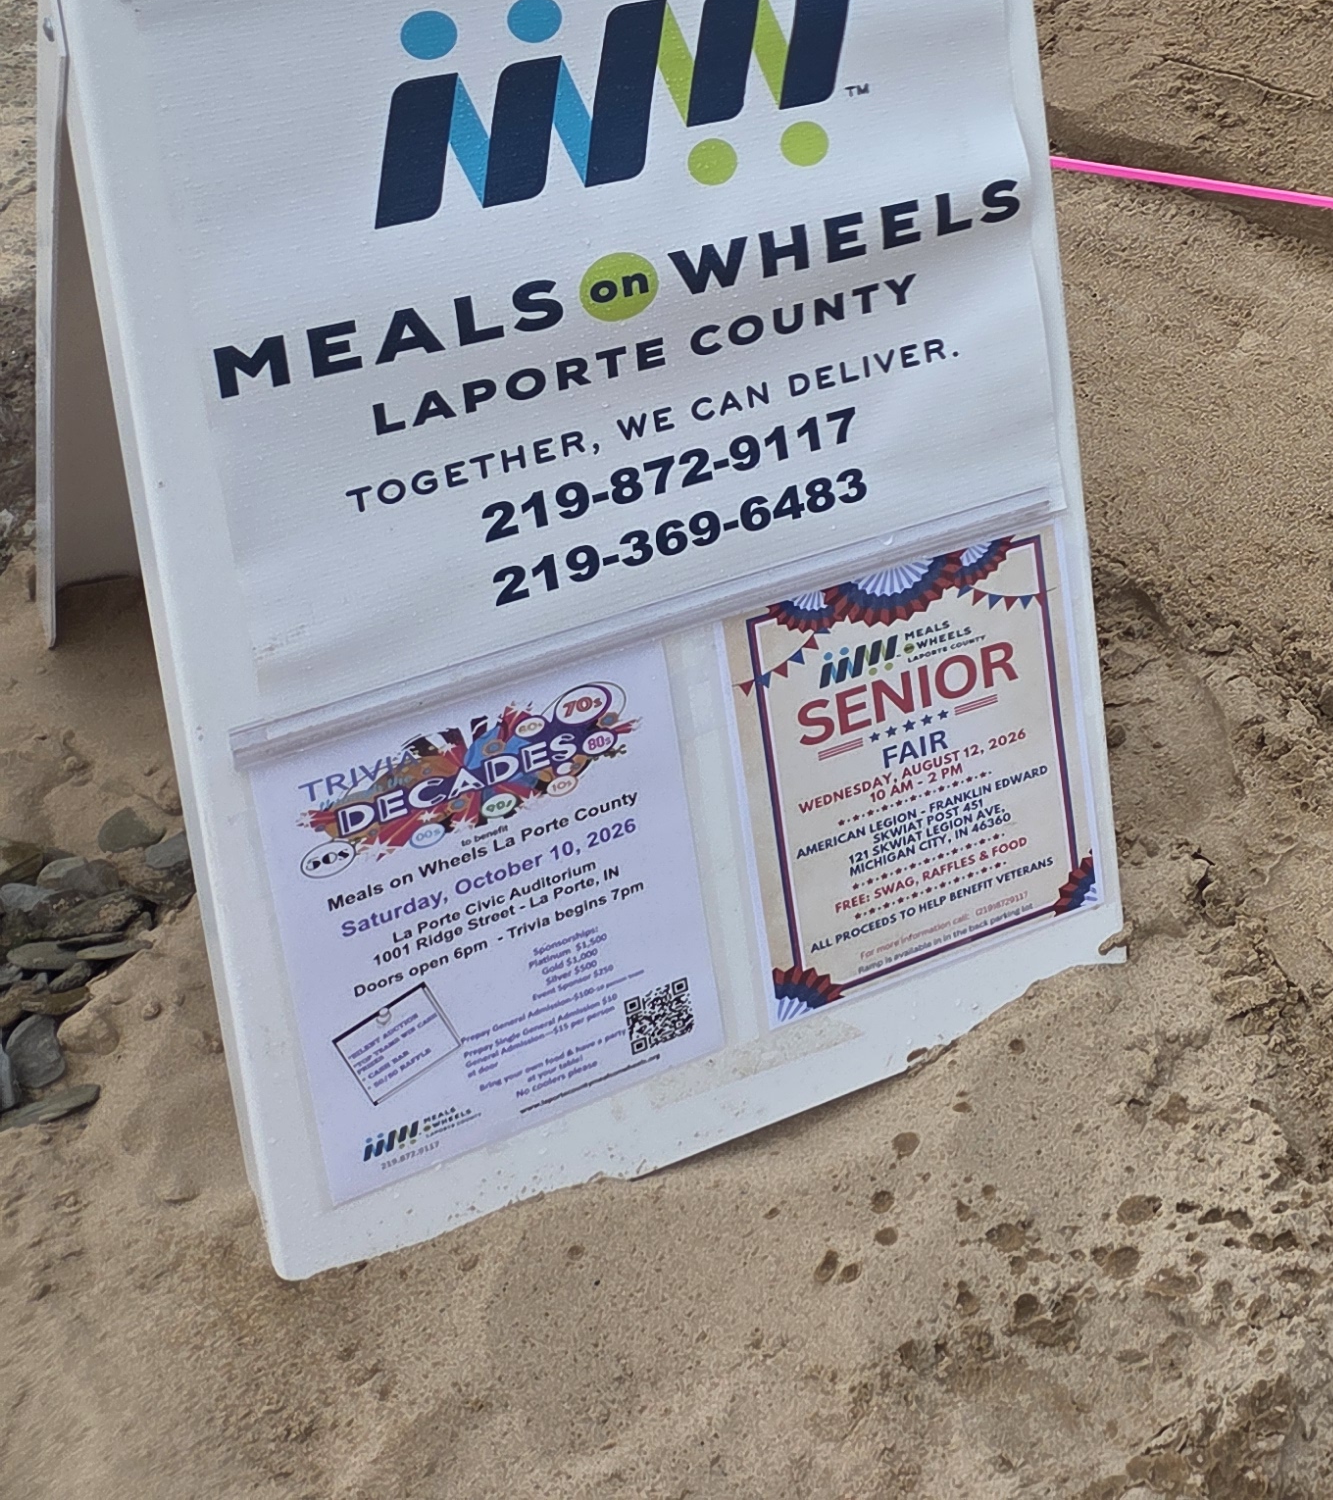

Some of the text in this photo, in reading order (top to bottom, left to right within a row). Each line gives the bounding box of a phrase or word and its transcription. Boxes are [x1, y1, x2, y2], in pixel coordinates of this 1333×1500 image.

[213, 179, 1020, 399] MEALS on WHEELS
[372, 273, 917, 436] LAPORTE COUNTY
[345, 338, 959, 513] TOGETHER, WE CAN DELIVER.
[481, 406, 856, 543] 219-872-9117
[492, 468, 867, 607] 219-369-6483
[904, 620, 950, 641] MEALS
[907, 646, 948, 663] LAPORTE
[950, 634, 986, 650] COUNTY
[916, 626, 972, 649] WHEELS
[562, 695, 603, 718] 70s
[797, 642, 1019, 746] SENIOR
[586, 735, 612, 750] 80s
[882, 730, 948, 769] FAIR
[298, 750, 420, 802] TRIVIA
[338, 732, 577, 835] DECADES
[798, 728, 1026, 814] WEDNESDAY, AUGUST 12, 2026
[870, 789, 886, 803] 10
[890, 779, 914, 797] AM
[927, 772, 938, 784] 2
[941, 762, 963, 780] PM
[461, 824, 508, 847] to benefit
[796, 826, 866, 860] AMERICAN
[869, 808, 917, 834] LEGION
[929, 783, 992, 813] FRANKLIN
[995, 765, 1048, 791] EDWARD
[873, 798, 983, 844] SKWIAT POST 451
[327, 792, 638, 912] Meals on Wheels La Porte County
[848, 850, 869, 865] 121
[872, 830, 922, 856] SKWIAT
[926, 813, 973, 838] LEGION
[850, 812, 1011, 877] MICHIGAN CITY, IN 46360
[341, 818, 636, 938] Saturday, October 10, 2026
[835, 837, 1027, 914] FREE: SWAG, RAFFLES & FOOD
[373, 943, 410, 966] 1001
[416, 926, 463, 951] Ridge
[467, 904, 516, 931] Street
[529, 894, 549, 908] La
[553, 878, 600, 900] Porte,
[603, 865, 619, 881] IN
[392, 862, 596, 944] La Porte Civic Auditorium
[810, 856, 1054, 954] ALL PROCEEDS TO HELP BENEFIT VETERANS
[354, 972, 404, 998] Doors
[408, 955, 449, 976] open
[454, 940, 488, 960] 6pm
[506, 917, 550, 939] Trivia
[554, 896, 607, 922] begins
[610, 882, 644, 901] 7pm
[528, 933, 608, 970] Platinum $1,500
[532, 926, 598, 956] Sponsorships:
[541, 948, 598, 975] Gold $1,000
[858, 903, 1034, 974] Ramp is available in in the back parking lot
[860, 949, 874, 960] For
[876, 939, 900, 954] more
[900, 920, 951, 945] information
[545, 959, 598, 986] Silver $500
[492, 1013, 526, 1032] General
[522, 1017, 556, 1036] General
[557, 1001, 600, 1023] Admission
[465, 1049, 500, 1068] General
[478, 1061, 498, 1075] door
[479, 1078, 502, 1092] Bring
[503, 1070, 523, 1084] your
[525, 1062, 544, 1073] own
[544, 1051, 565, 1066] food
[575, 1041, 596, 1053] have
[604, 1029, 626, 1043] party
[516, 1060, 598, 1098] No coolers please
[537, 1066, 557, 1080] your
